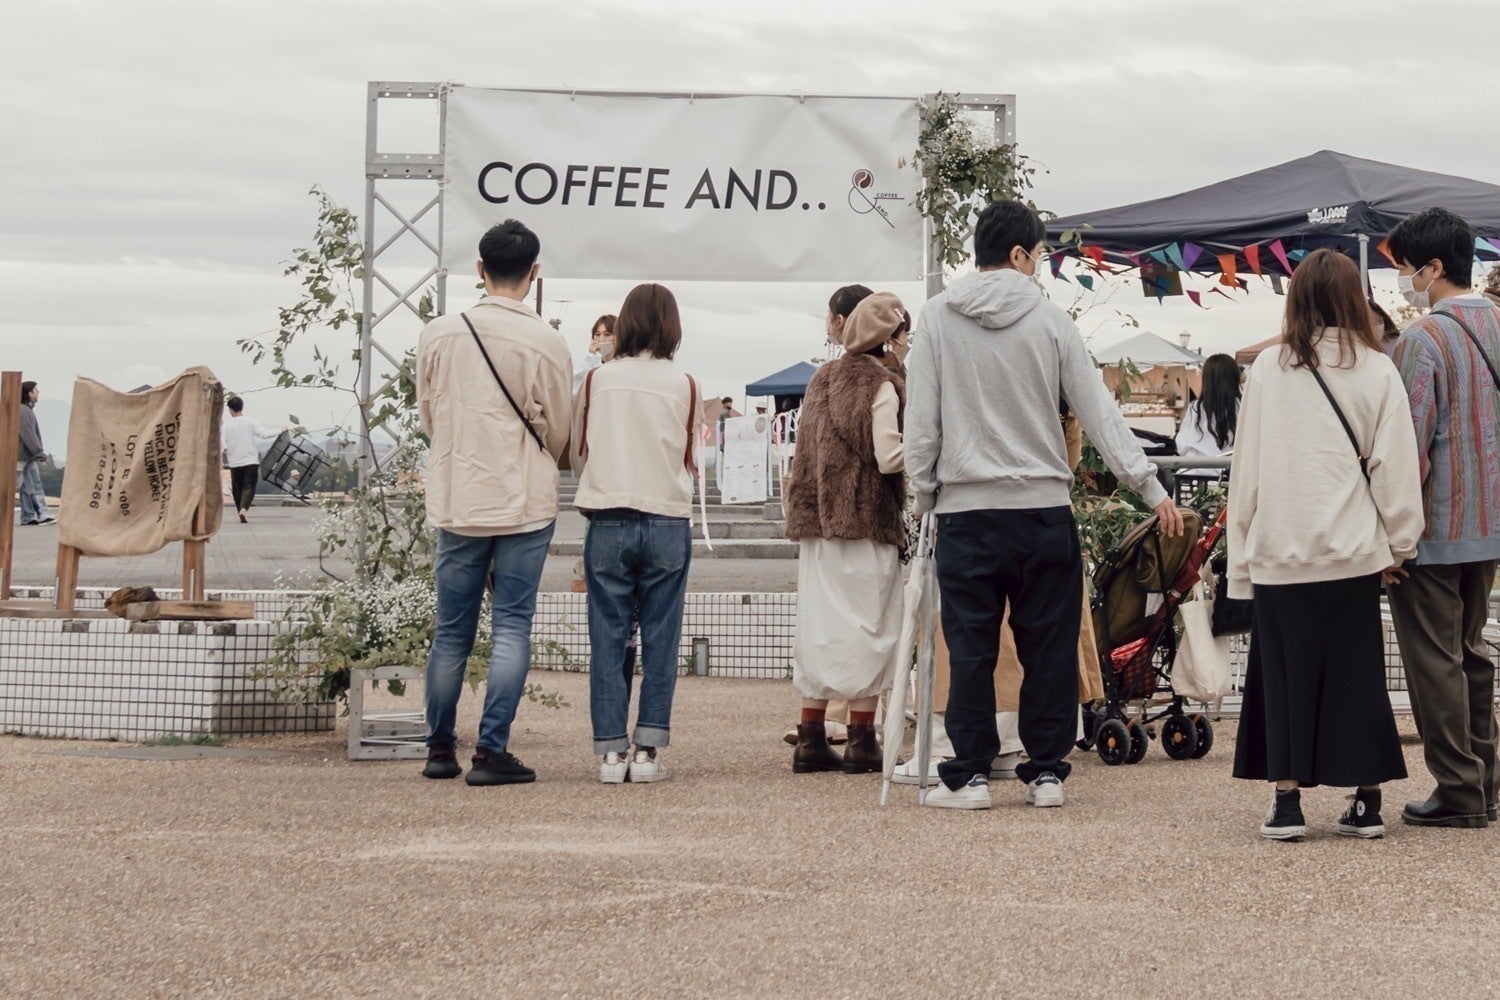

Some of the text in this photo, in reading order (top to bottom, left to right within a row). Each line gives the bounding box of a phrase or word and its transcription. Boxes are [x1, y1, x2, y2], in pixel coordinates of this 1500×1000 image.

[478, 162, 825, 211] COFFEE AND..
[876, 205, 889, 217] AND
[125, 434, 138, 459] LOT
[155, 423, 165, 456] FINCA
[164, 422, 176, 462] DON
[144, 439, 161, 502] YELLOW HONEY
